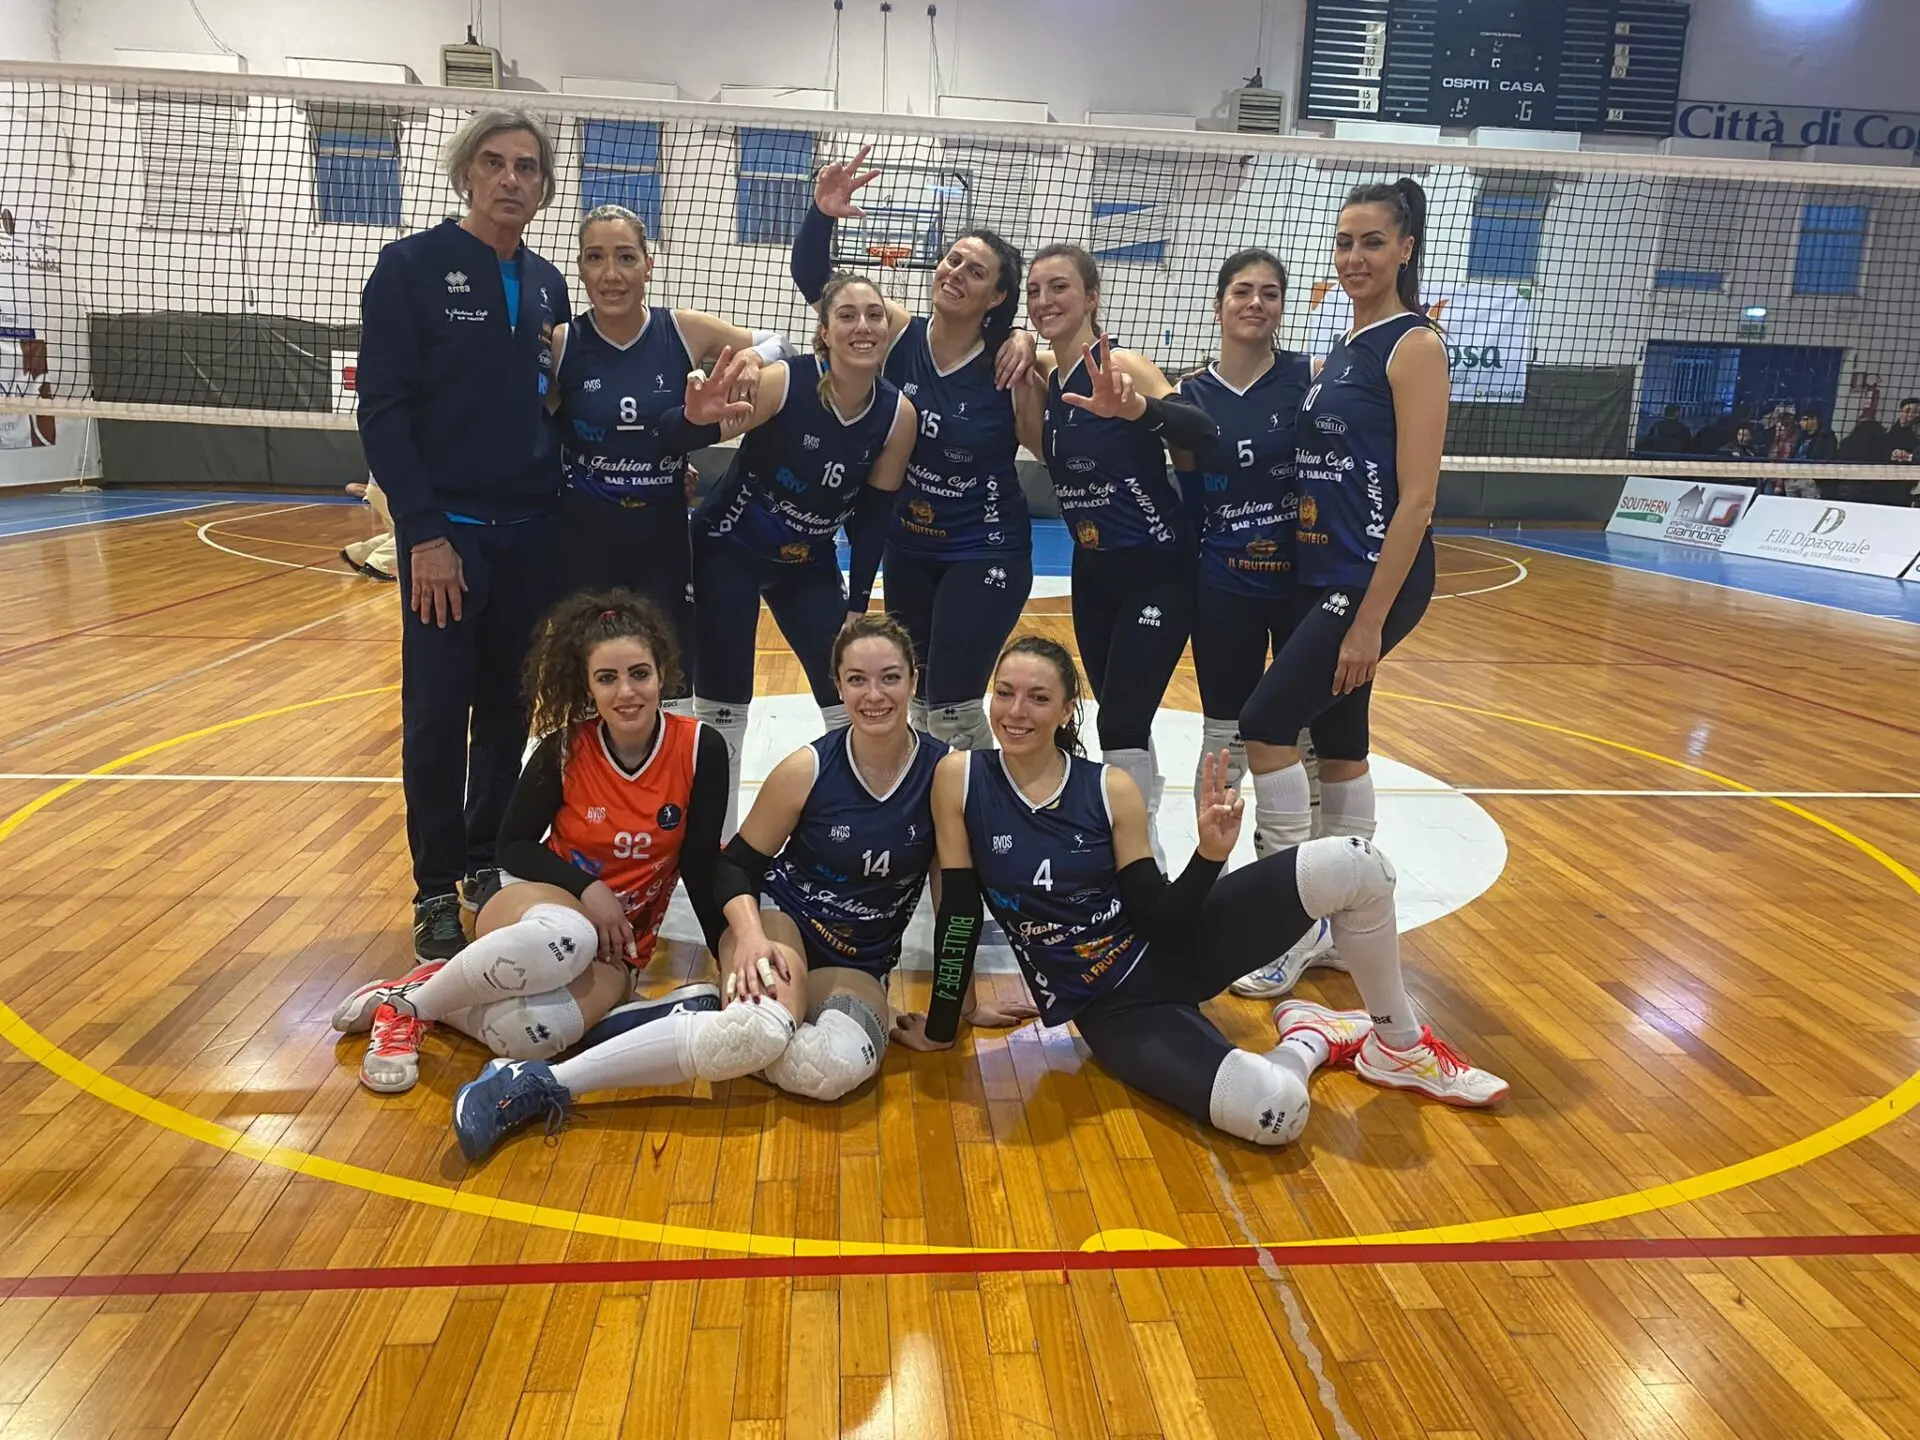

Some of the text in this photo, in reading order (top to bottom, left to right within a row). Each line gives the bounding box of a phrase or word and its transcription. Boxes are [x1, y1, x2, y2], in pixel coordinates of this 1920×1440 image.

[1442, 78, 1545, 93] OSPITI CASA
[1678, 104, 1920, 156] Città di Co
[619, 396, 638, 424] 8
[920, 409, 942, 440] 15
[590, 456, 653, 473] Fashion
[1237, 439, 1255, 468] 5
[604, 476, 625, 486] BAR
[630, 475, 673, 486] TABACCHI
[820, 461, 846, 488] 16
[779, 500, 831, 526] Fashion
[1217, 500, 1274, 520] Fashion
[1619, 496, 1671, 515] SOUTHERN
[1231, 519, 1250, 532] BAR
[1790, 531, 1872, 555] Dipasquale
[1228, 557, 1292, 572] IL FRUTTETO
[613, 831, 652, 860] 92
[862, 849, 891, 877] 14
[1032, 858, 1054, 892] 4
[941, 915, 975, 956] BULLE
[936, 958, 965, 991] VERE
